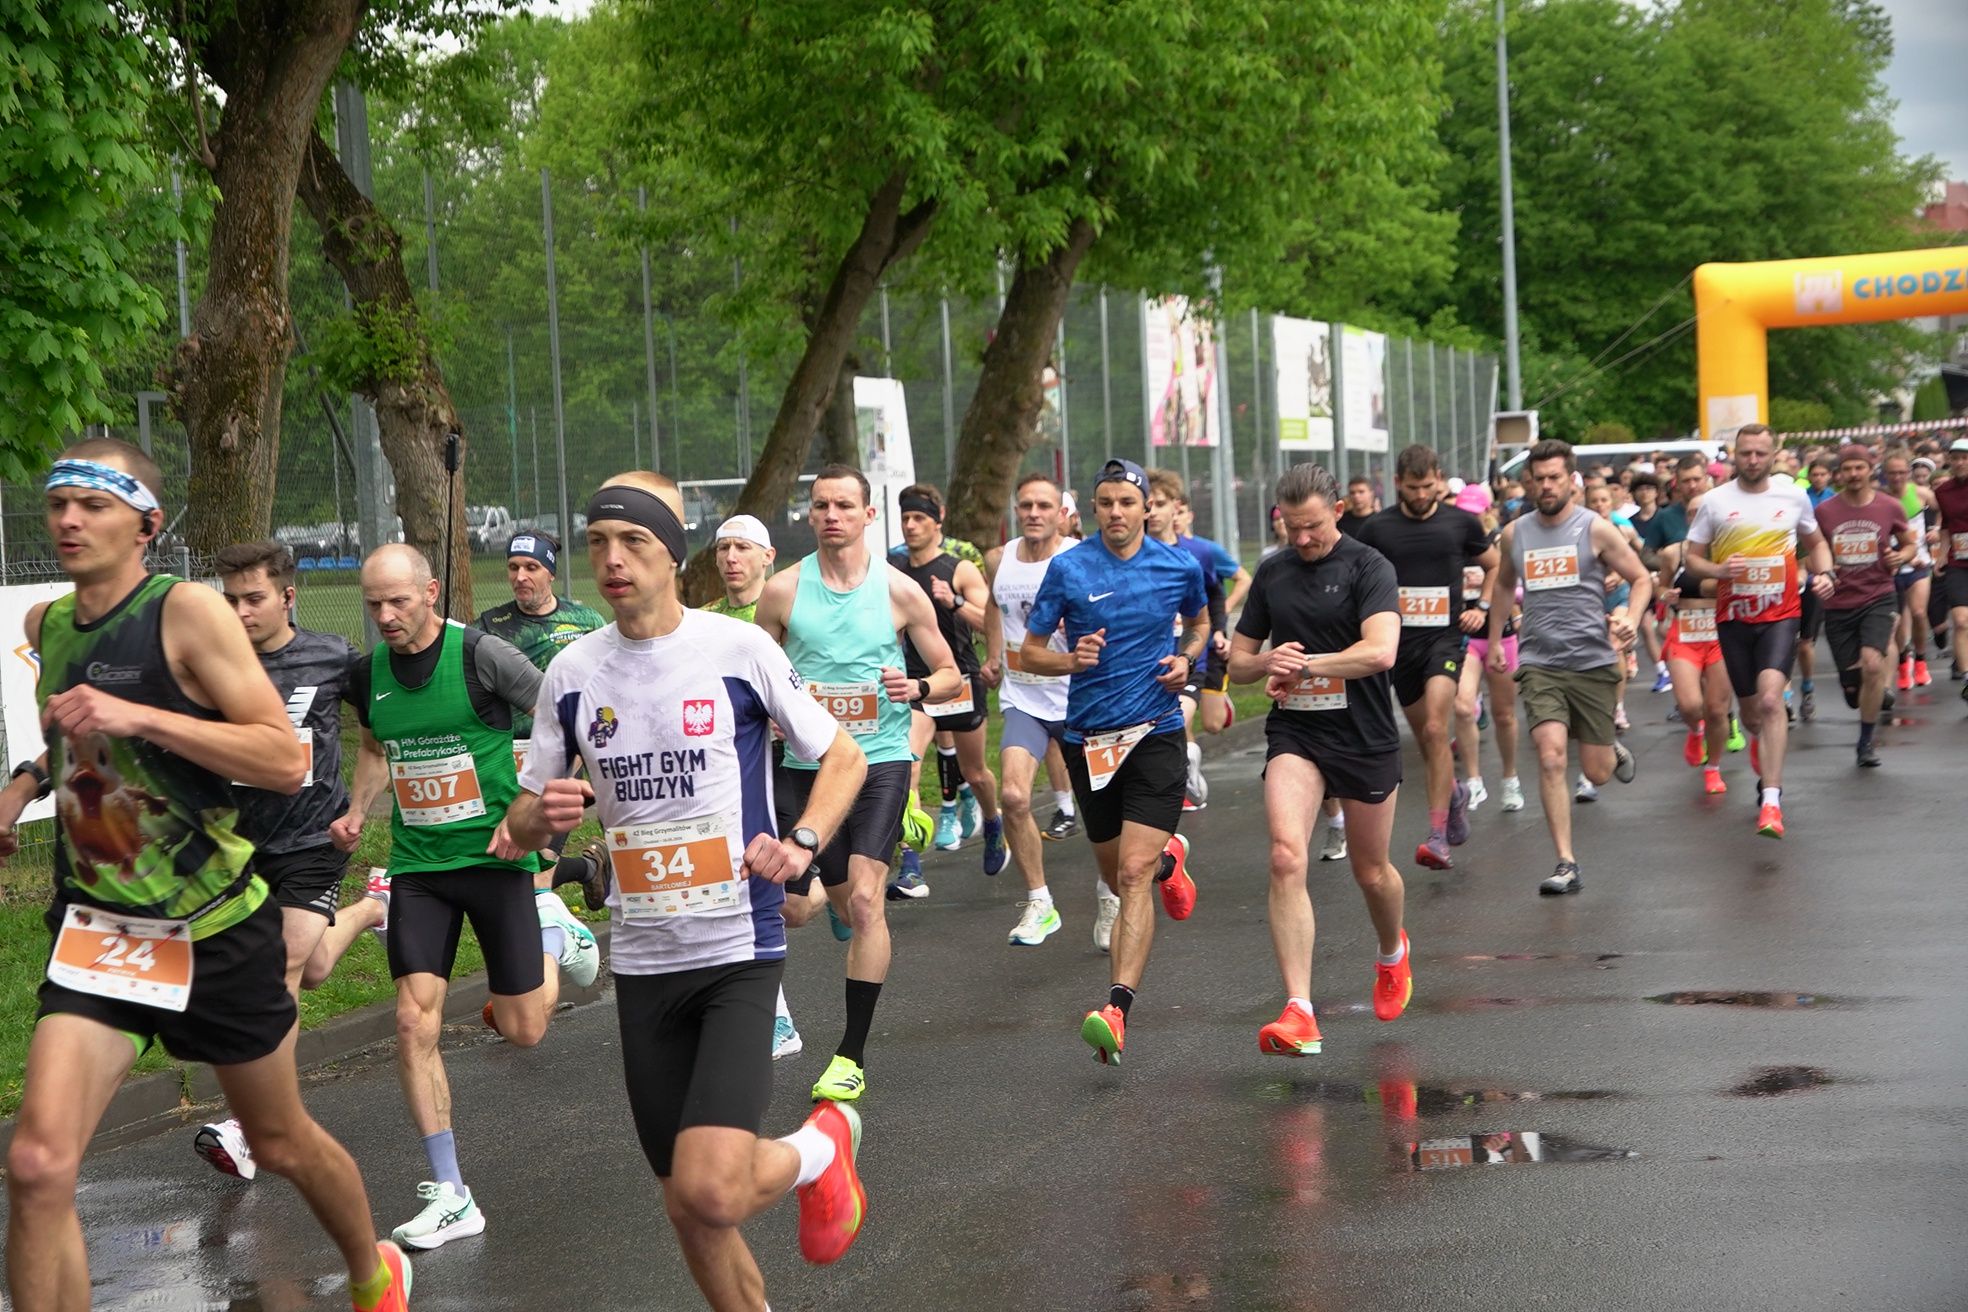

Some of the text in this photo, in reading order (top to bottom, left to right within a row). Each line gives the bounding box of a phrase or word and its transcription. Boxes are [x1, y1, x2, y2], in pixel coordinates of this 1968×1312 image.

[1854, 268, 1968, 299] CHODZ
[1842, 542, 1869, 553] 276
[1534, 558, 1568, 576] 212
[1747, 567, 1771, 581] 85
[1406, 599, 1439, 612] 217
[1728, 593, 1782, 621] RUN
[401, 733, 461, 747] HM Górażdże
[403, 744, 468, 758] Prefabrykacja
[598, 749, 706, 779] FIGHT GYM
[408, 774, 459, 802] 307
[615, 770, 695, 802] BUDZYŃ
[633, 824, 692, 837] 42 Bieg Grzymalitów
[642, 846, 695, 882] 34
[650, 880, 692, 891] BARTŁOMIEJ
[94, 936, 156, 972] 24
